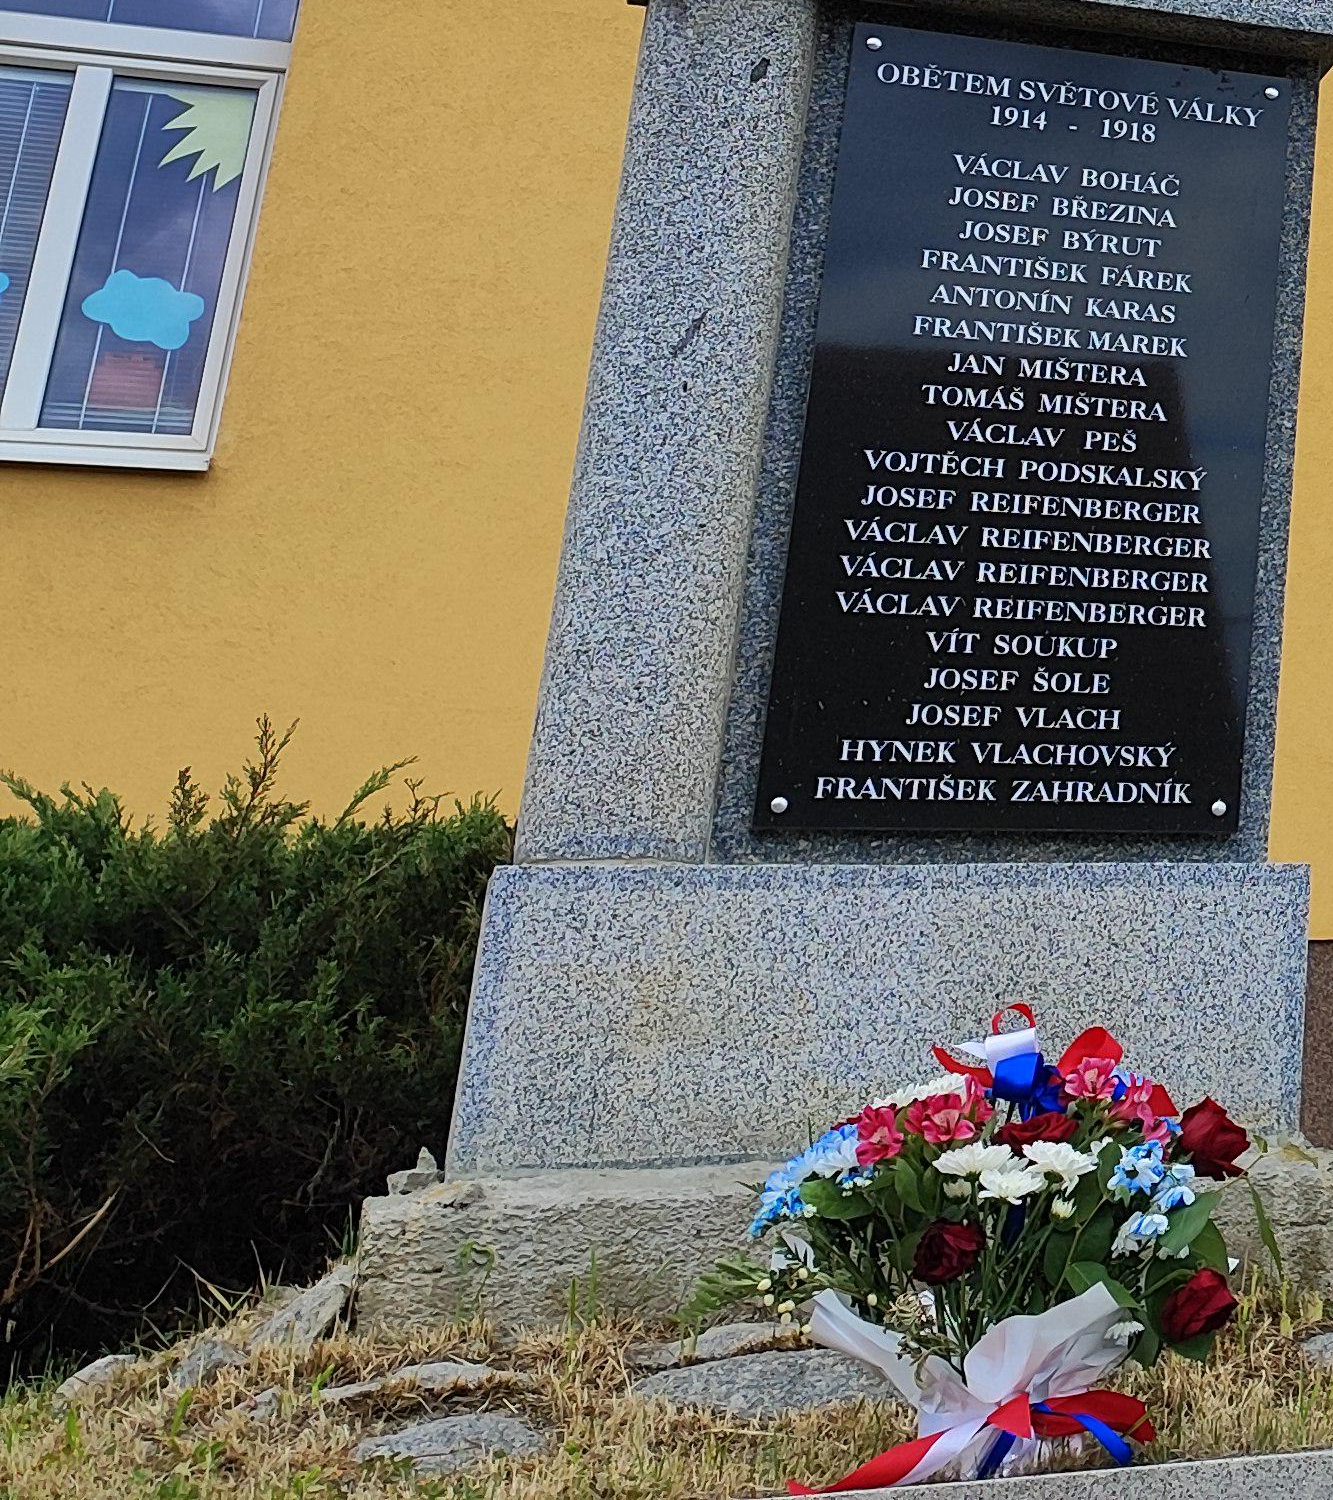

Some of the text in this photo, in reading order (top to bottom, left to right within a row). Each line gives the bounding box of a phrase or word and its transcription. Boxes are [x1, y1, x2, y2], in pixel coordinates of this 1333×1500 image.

[877, 63, 1264, 128] OBĚTEM SVĚTOVÉ VÁLKY
[990, 105, 1048, 131] 1914
[1100, 118, 1156, 143] 1918
[953, 152, 1180, 197] VÁCLAV BOHÁČ
[948, 186, 1177, 229] JOSEF BŘEZINA
[958, 220, 1162, 258] JOSEF BÝRUT
[919, 248, 1193, 293] FRANTIŠEK FÁREK
[929, 284, 1176, 324] ANTONÍN KARAS
[912, 315, 1188, 358] FRANTIŠEK MAREK
[947, 352, 1148, 387] JAN MIŠTERA
[921, 384, 1168, 422] TOMÁŠ MIŠTERA
[946, 417, 1137, 453] VÁCLAV PEŠ
[863, 449, 1208, 491] VOJTĚCH PODSKALSKÝ
[860, 484, 1202, 525] JOSEF REIFENBERGER
[843, 516, 1213, 559] VÁCLAV REIFENBERGER
[839, 551, 1209, 593] VÁCLAV REIFENBERGER
[835, 587, 1207, 628] VÁCLAV REIFENBERGER
[926, 627, 1118, 659] VÍT SOUKUP
[923, 666, 1111, 694] JOSEF ŠOLE
[905, 703, 1122, 730] JOSEF VLACH
[839, 739, 1177, 768] HYNEK VLACHOVSKÝ
[814, 773, 1192, 804] FRANTIŠEK ZAHRADNÍK
